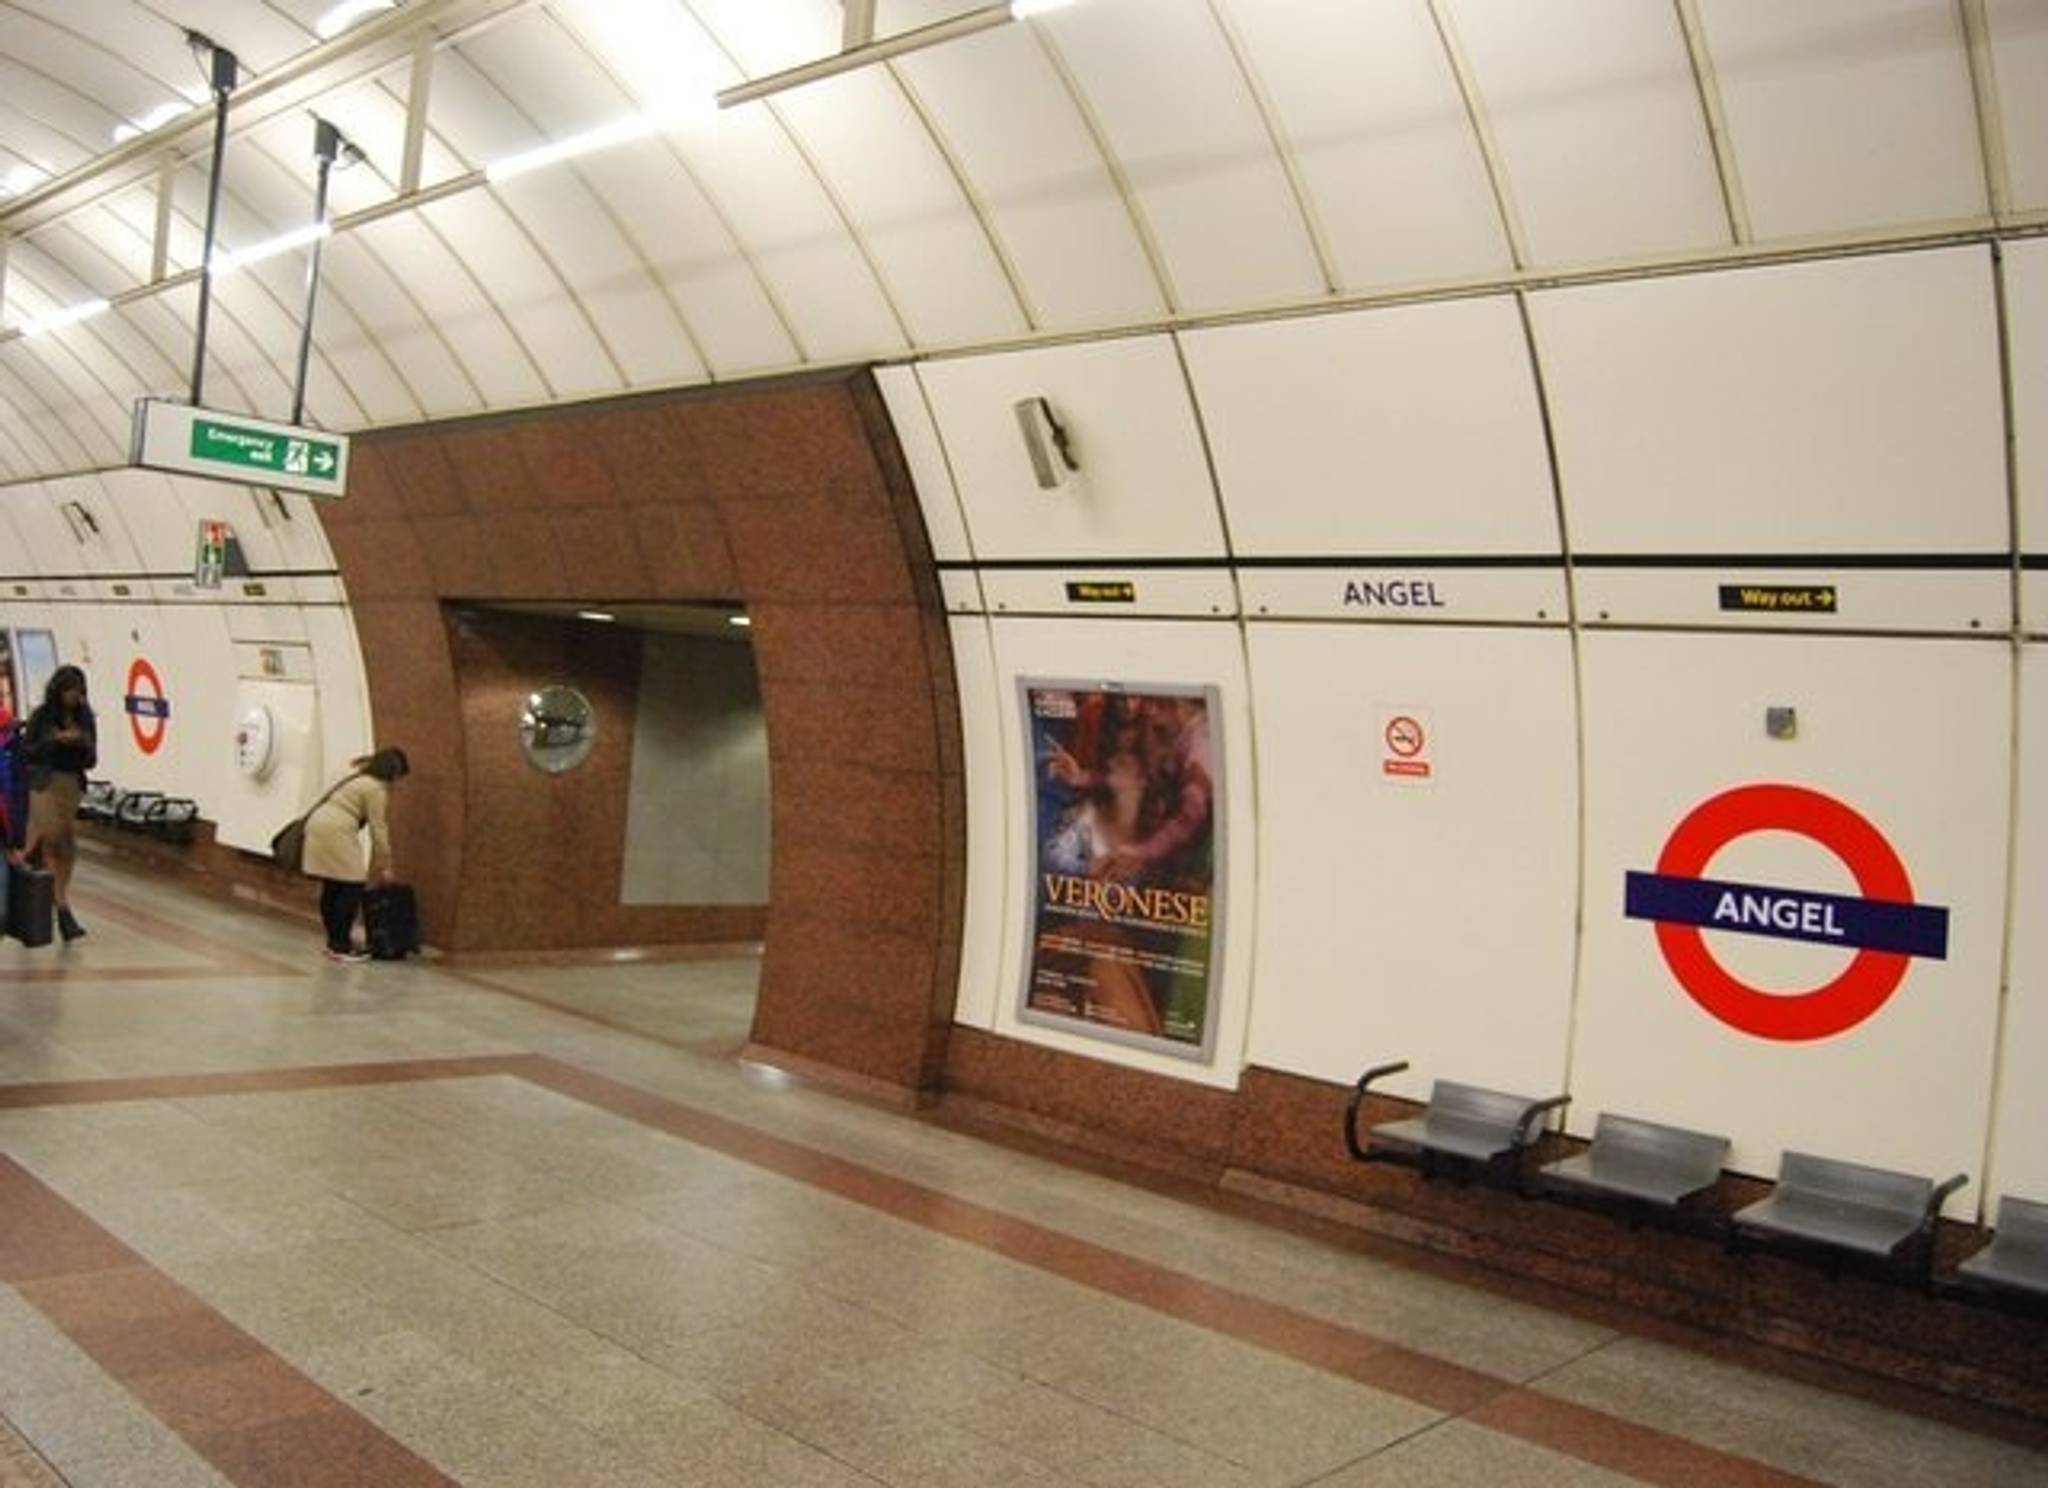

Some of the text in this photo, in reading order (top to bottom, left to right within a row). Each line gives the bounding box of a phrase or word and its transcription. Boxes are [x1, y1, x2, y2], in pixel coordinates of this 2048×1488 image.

[1344, 581, 1445, 606] ANGEL
[1740, 588, 1813, 608] Way out
[1045, 873, 1208, 926] VERONESE
[1714, 891, 1845, 936] ANGEL
